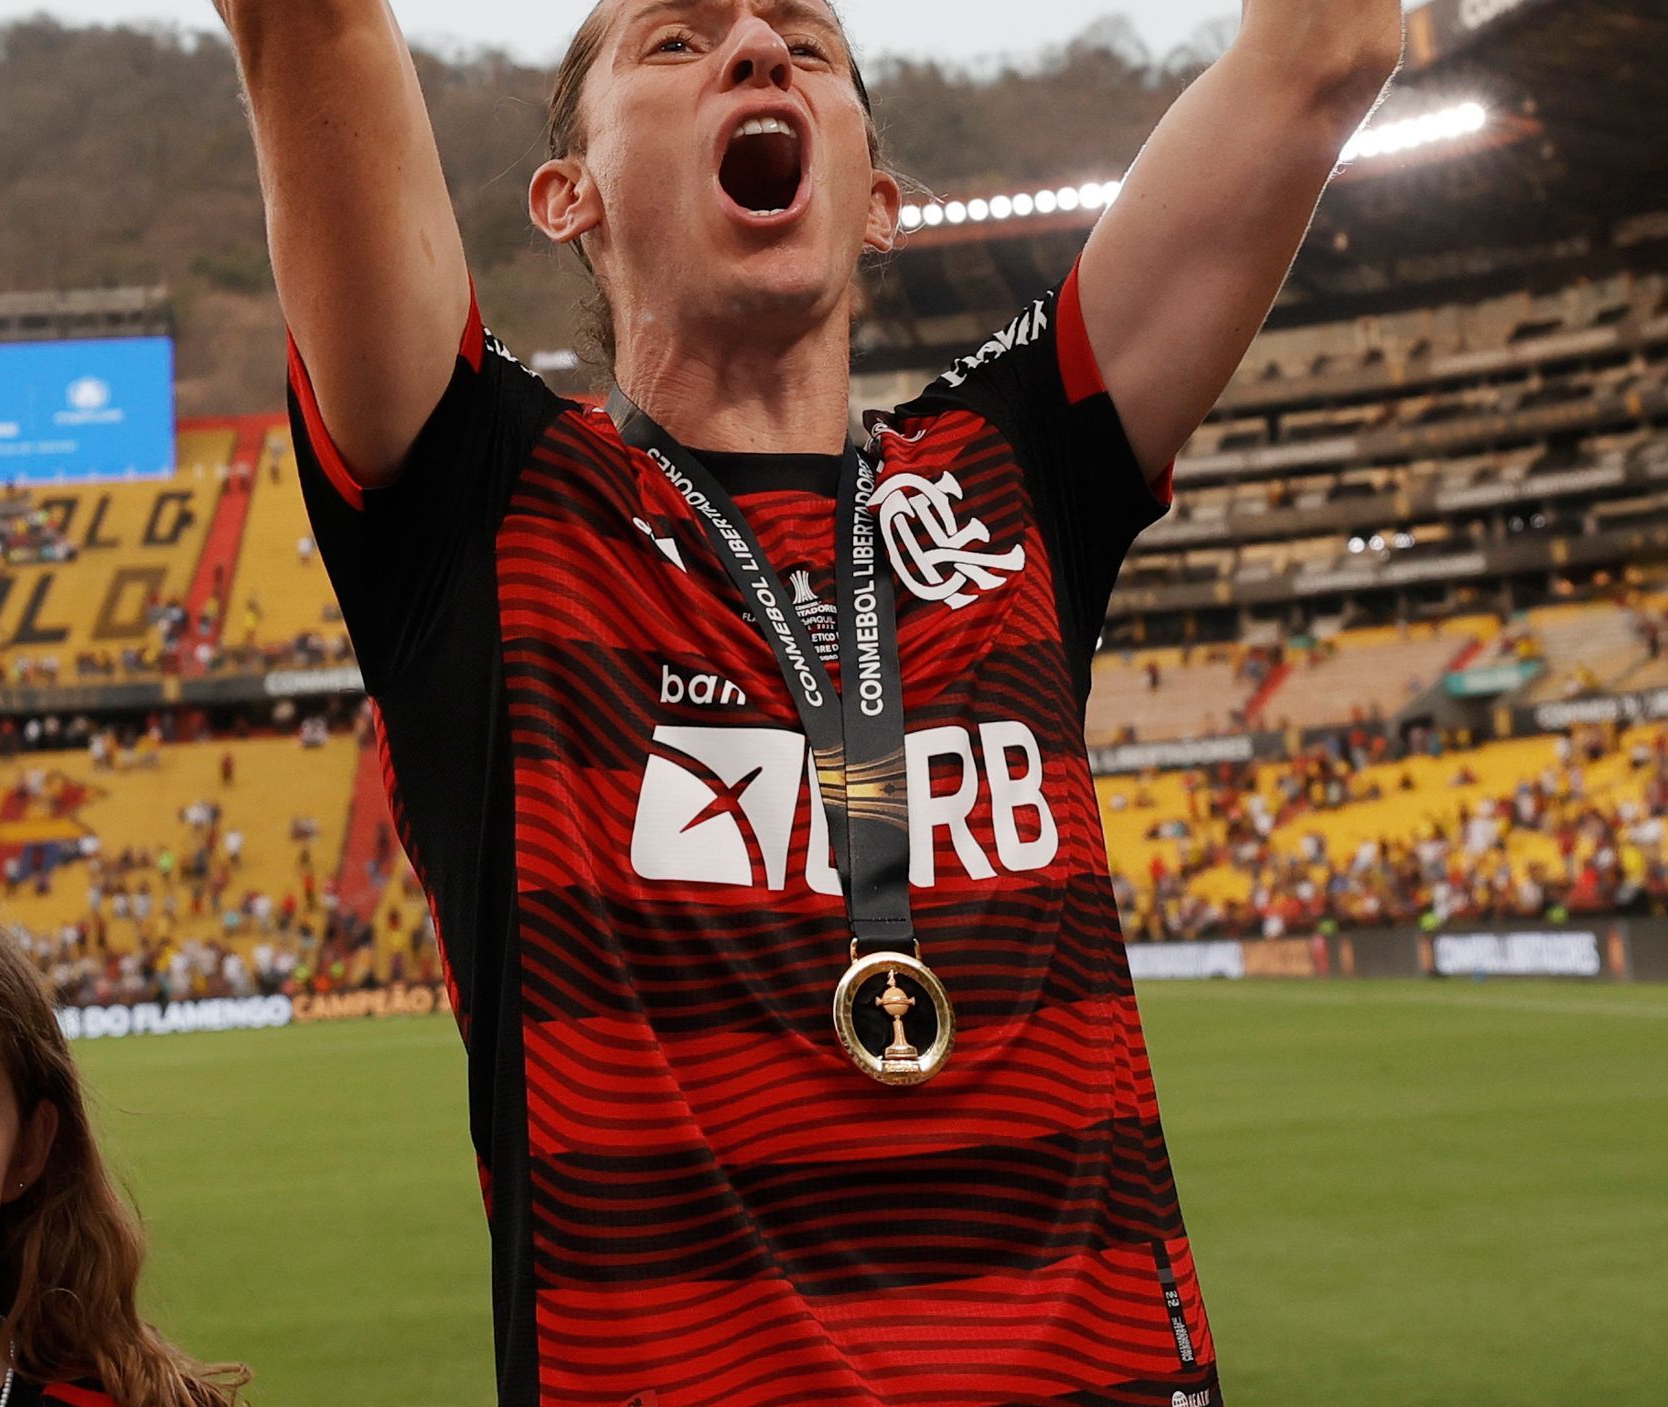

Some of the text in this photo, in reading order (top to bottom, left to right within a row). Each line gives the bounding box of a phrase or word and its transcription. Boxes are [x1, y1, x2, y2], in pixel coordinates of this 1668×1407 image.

[751, 576, 823, 707] CONMEBOL
[853, 579, 884, 717] CONMEBOL
[84, 1003, 131, 1039] DO
